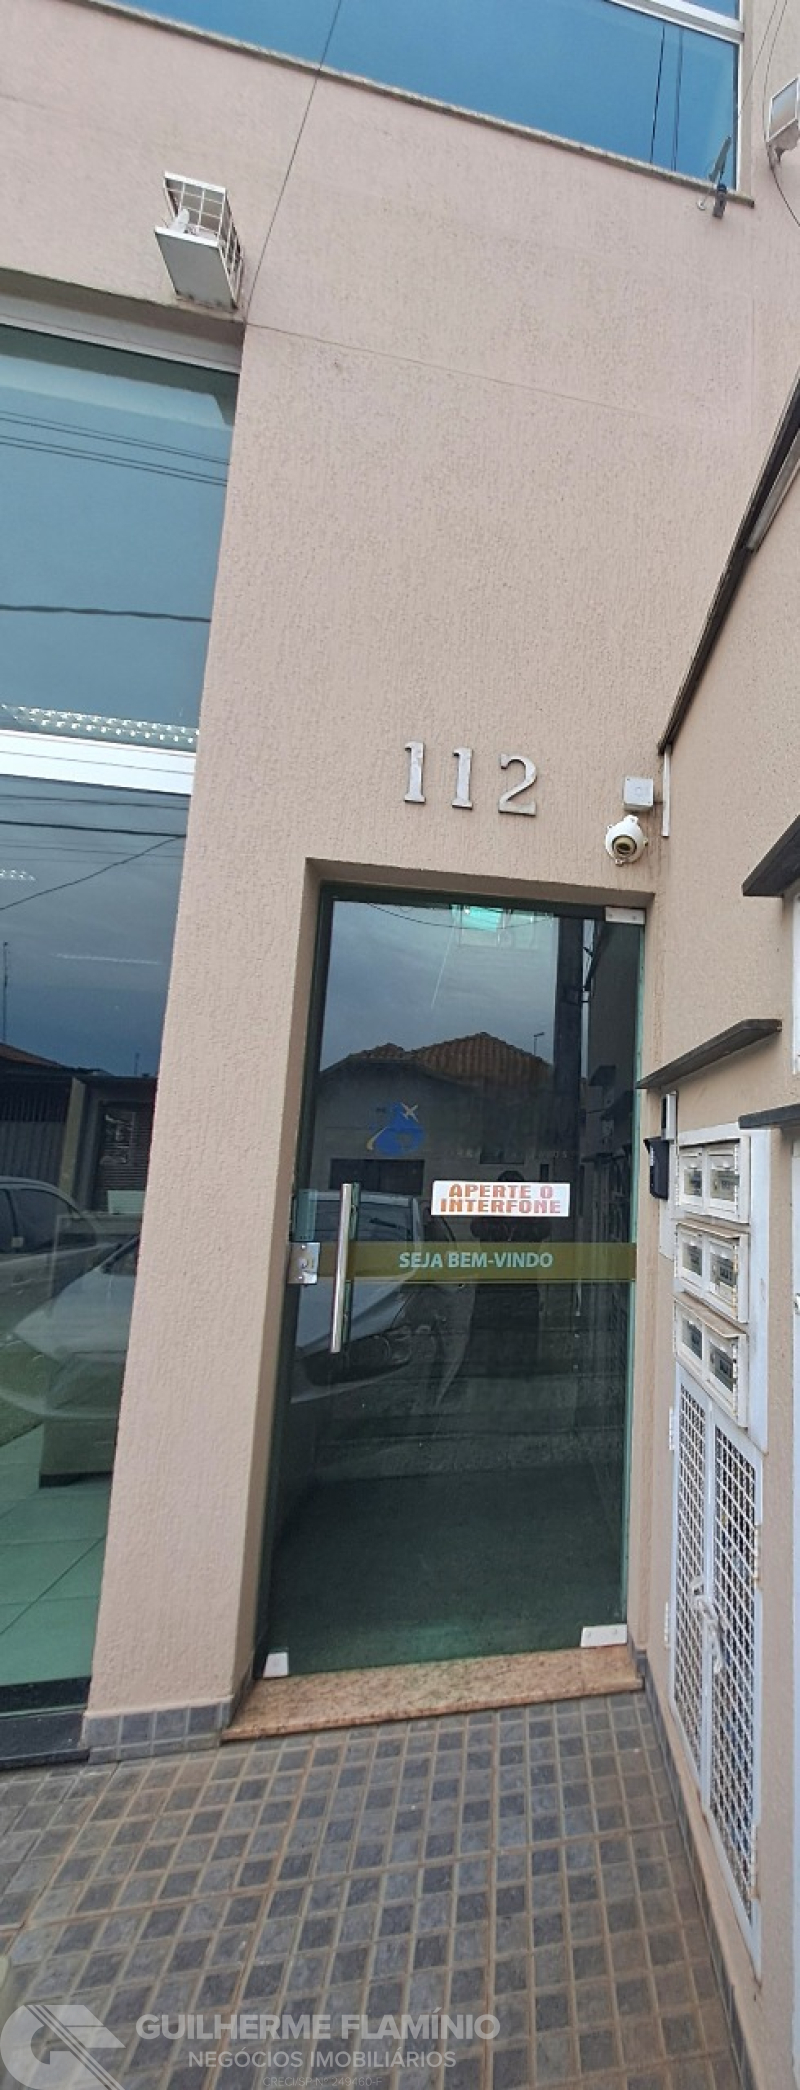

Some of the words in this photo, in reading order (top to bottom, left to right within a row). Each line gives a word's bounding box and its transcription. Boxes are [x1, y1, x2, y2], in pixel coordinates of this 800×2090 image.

[404, 741, 538, 816] 112
[449, 1184, 531, 1199] APERTE
[540, 1185, 554, 1199] O
[441, 1199, 561, 1213] INTERFONE
[399, 1252, 443, 1268] SEJA
[448, 1252, 553, 1268] BEM-VINDO
